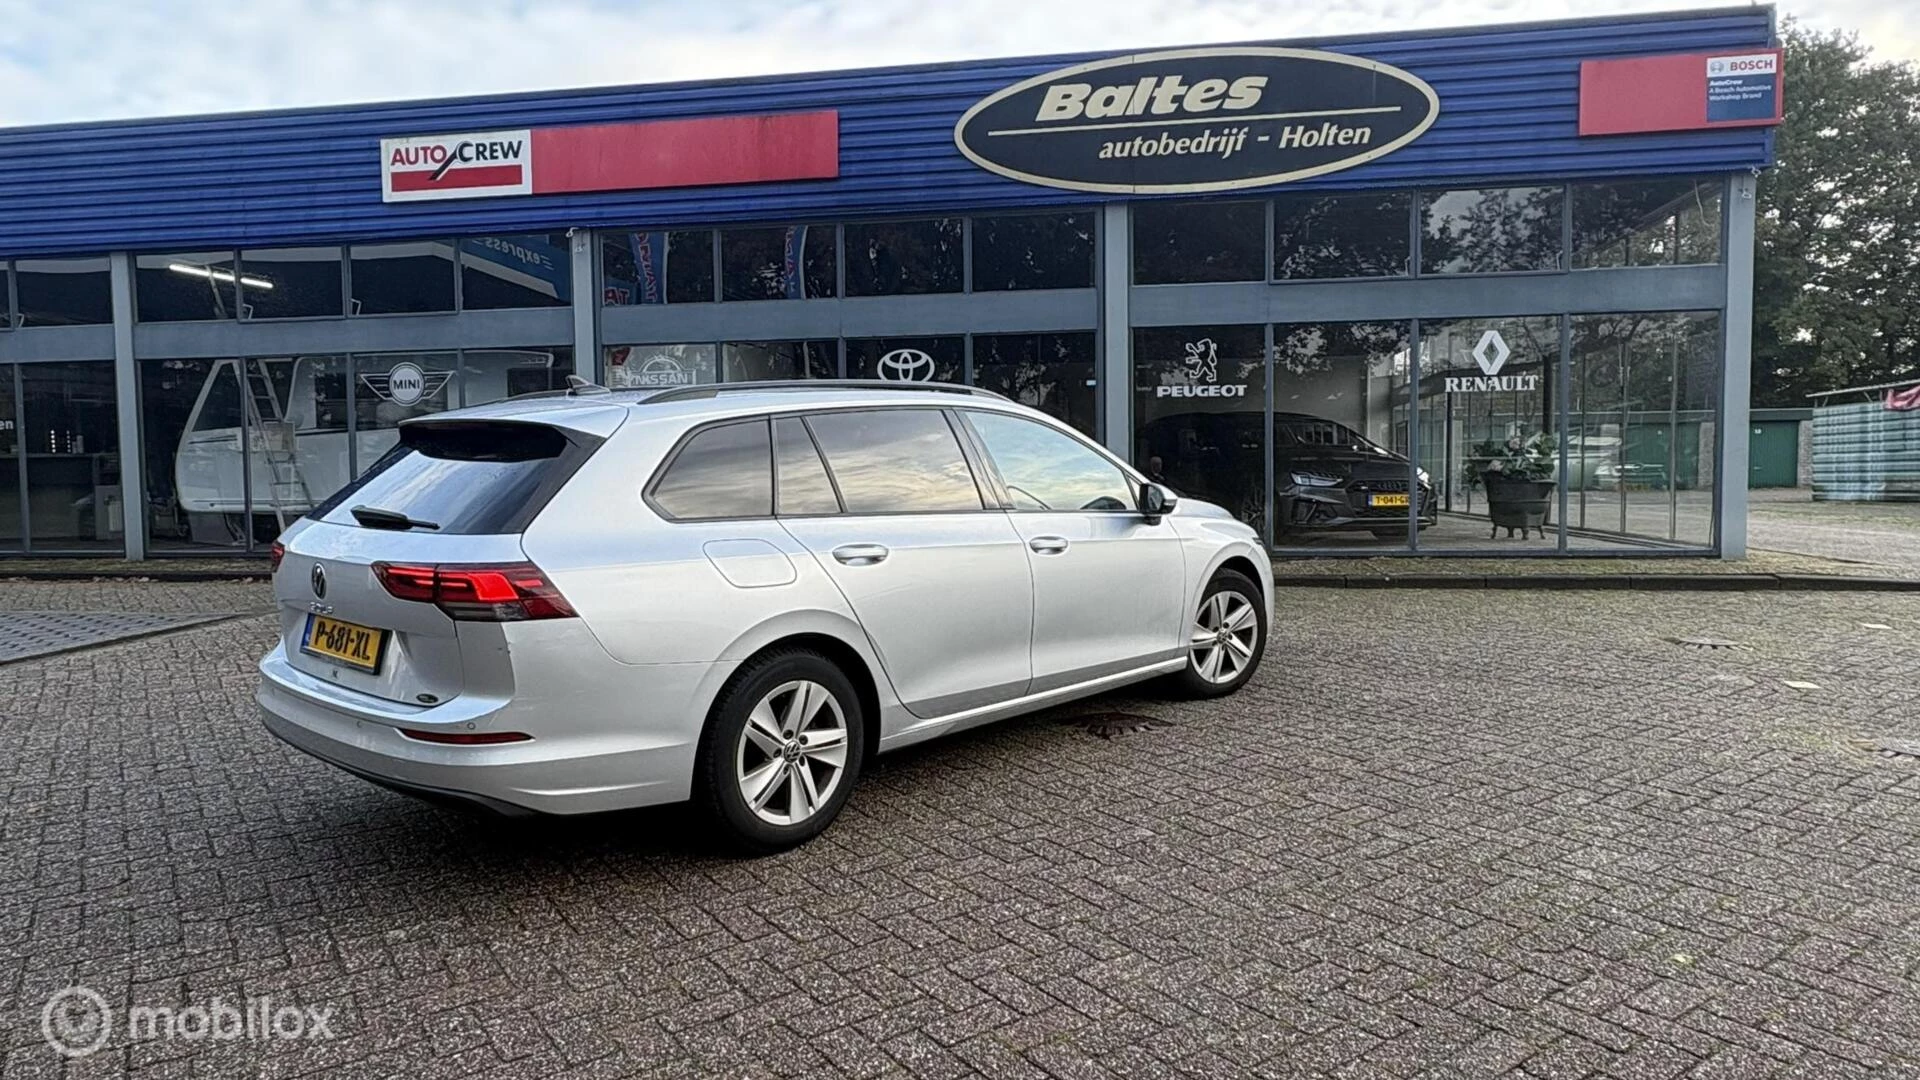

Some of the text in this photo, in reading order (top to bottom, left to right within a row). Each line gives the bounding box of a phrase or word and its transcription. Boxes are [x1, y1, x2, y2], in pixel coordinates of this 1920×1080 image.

[1730, 60, 1773, 71] BOSCH
[1035, 74, 1269, 122] Baltes
[1099, 128, 1250, 160] autobedrijf
[1278, 122, 1372, 149] Holten
[391, 140, 523, 166] AUTO CREW
[393, 379, 420, 391] MINI
[635, 373, 688, 385] NISSAN
[1444, 374, 1539, 393] RENAULT
[1157, 385, 1247, 398] PEUGEOT
[314, 621, 371, 660] P-681-XL
